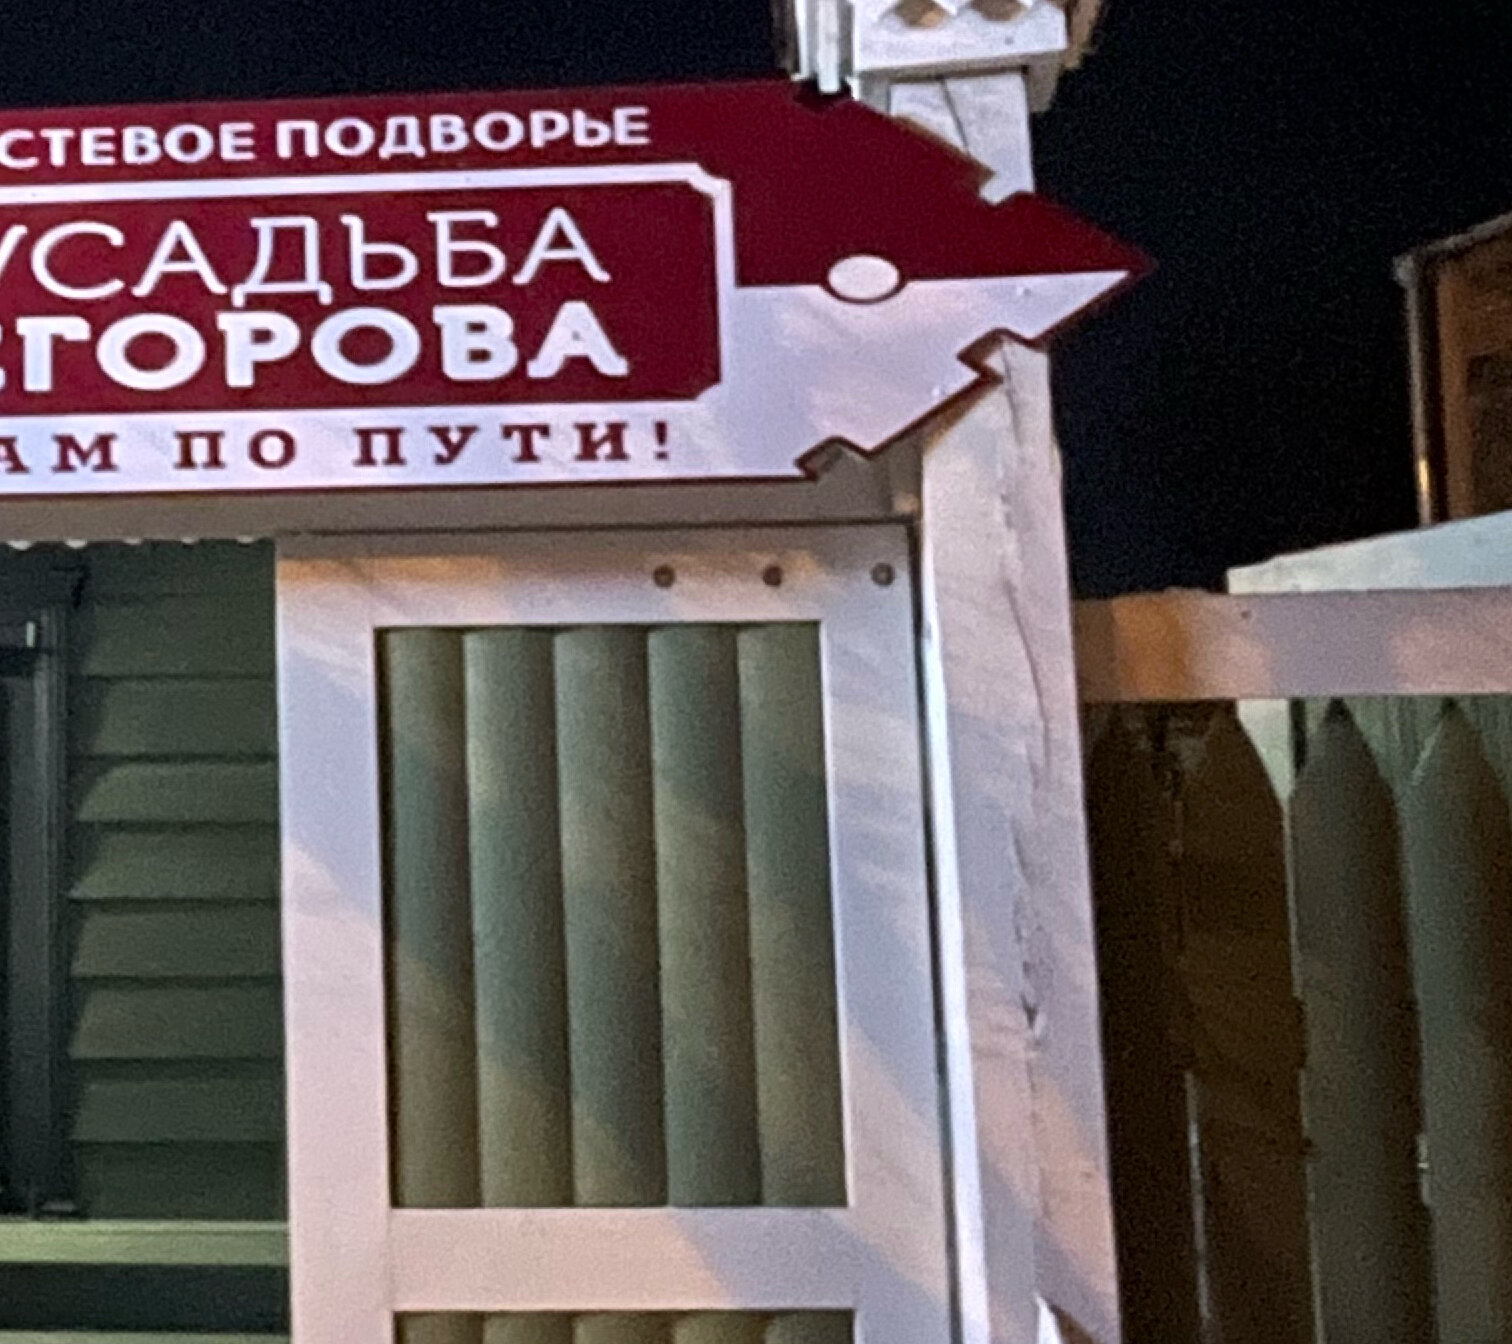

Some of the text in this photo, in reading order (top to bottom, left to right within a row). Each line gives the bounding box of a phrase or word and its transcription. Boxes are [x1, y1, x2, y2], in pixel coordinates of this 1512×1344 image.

[276, 106, 651, 160] ПОДВОРЬЕ
[174, 429, 297, 470] ПО
[353, 420, 669, 467] ПУТИ!
